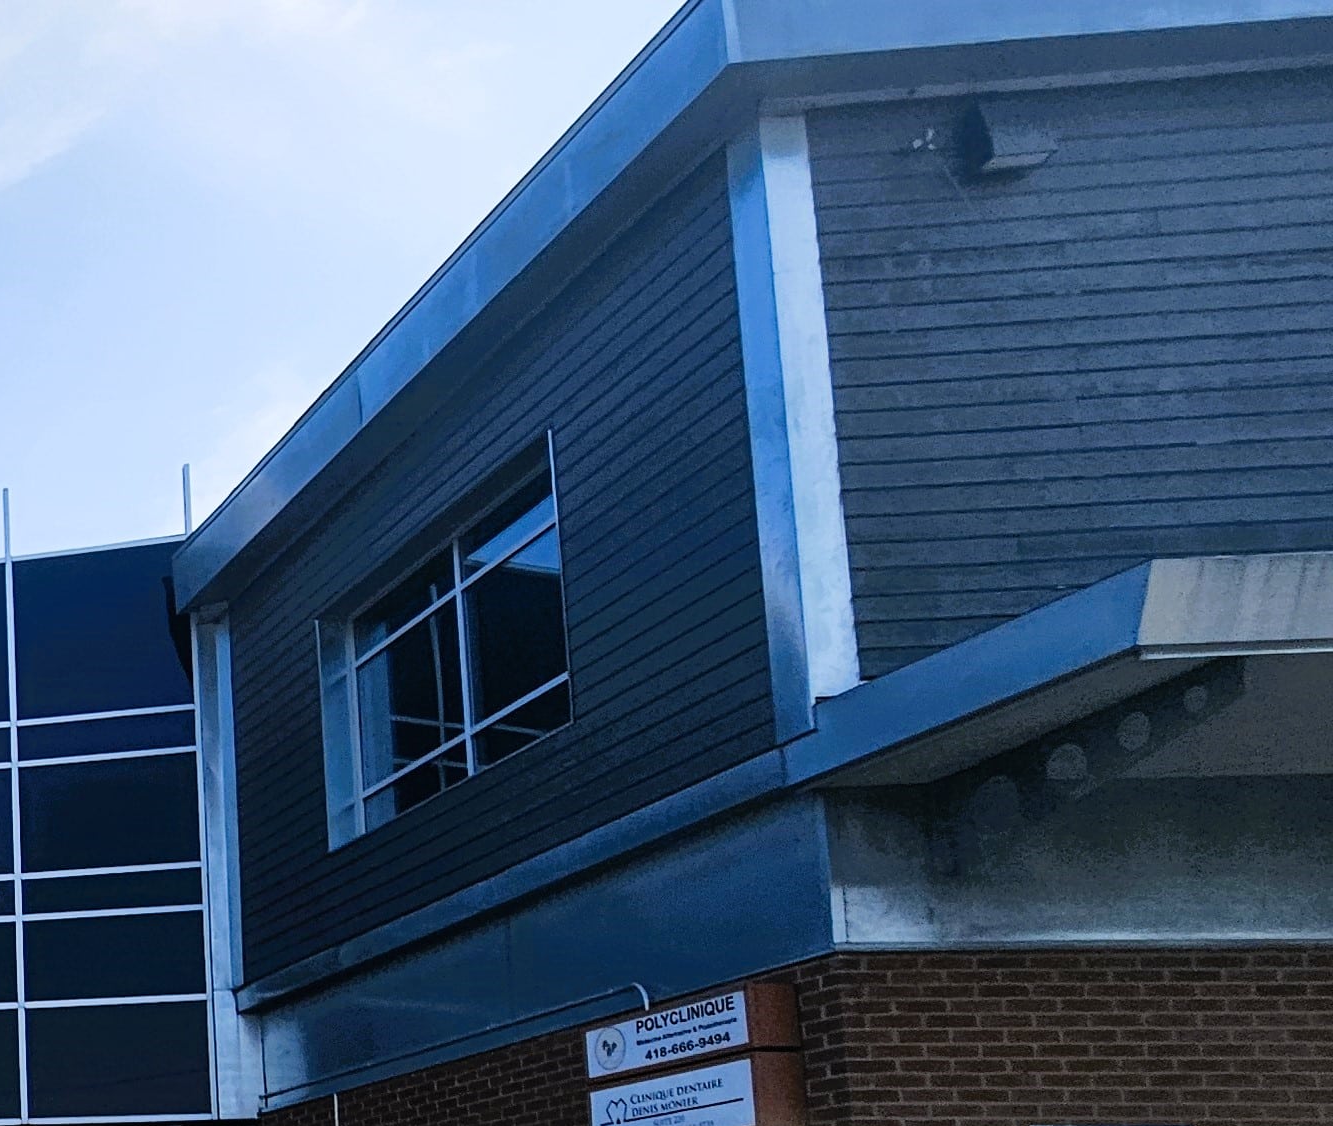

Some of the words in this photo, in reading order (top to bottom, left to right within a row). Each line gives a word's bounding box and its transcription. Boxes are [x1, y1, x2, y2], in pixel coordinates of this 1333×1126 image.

[636, 996, 735, 1033] POLYCLINIQUE
[645, 1032, 731, 1060] 418-666-9494
[630, 1087, 674, 1105] CLINIQUE
[676, 1078, 724, 1096] DENTAIRE
[632, 1104, 659, 1117] DENIS
